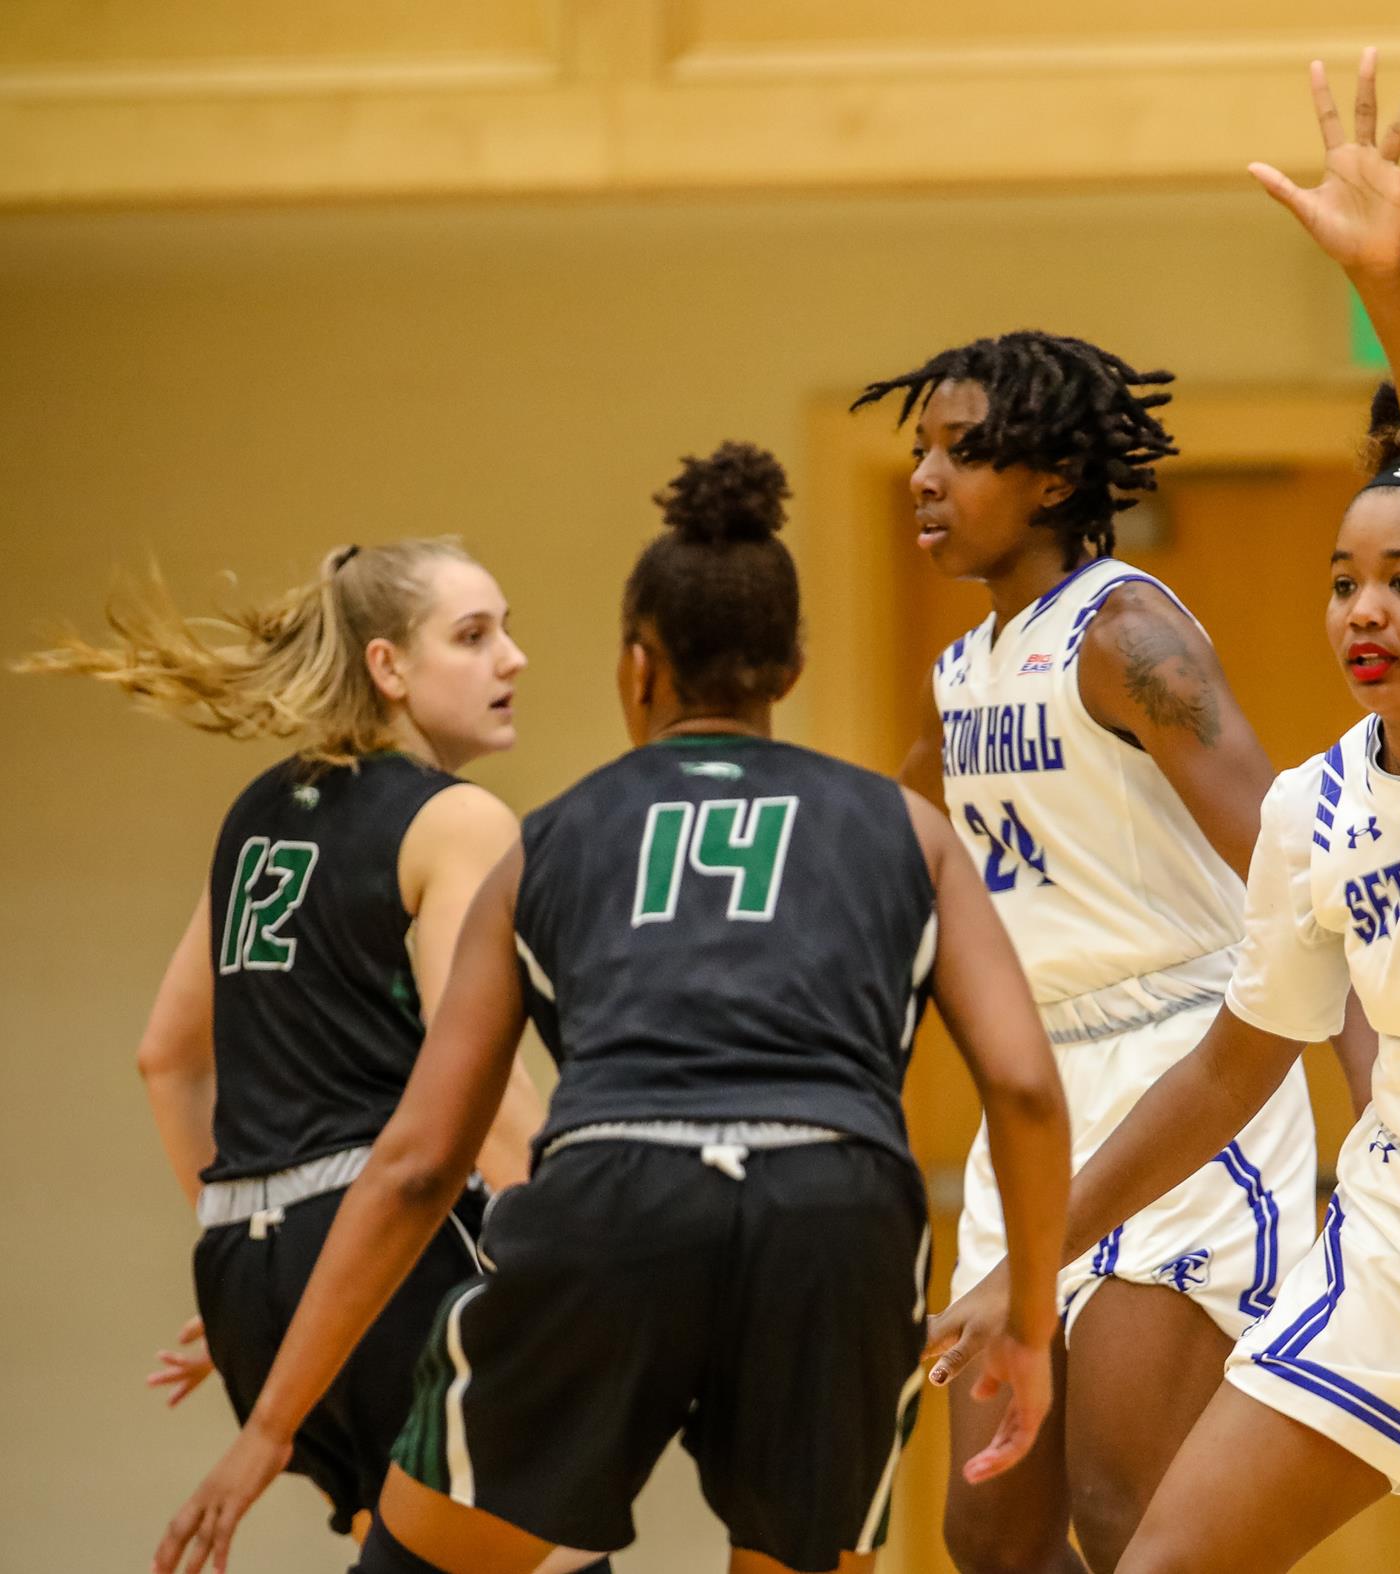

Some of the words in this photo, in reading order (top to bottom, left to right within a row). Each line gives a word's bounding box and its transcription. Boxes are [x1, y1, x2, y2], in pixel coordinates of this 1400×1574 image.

[985, 703, 1066, 774] HALL
[631, 796, 799, 928] 14
[964, 800, 1056, 893] 24
[219, 836, 319, 975] 12
